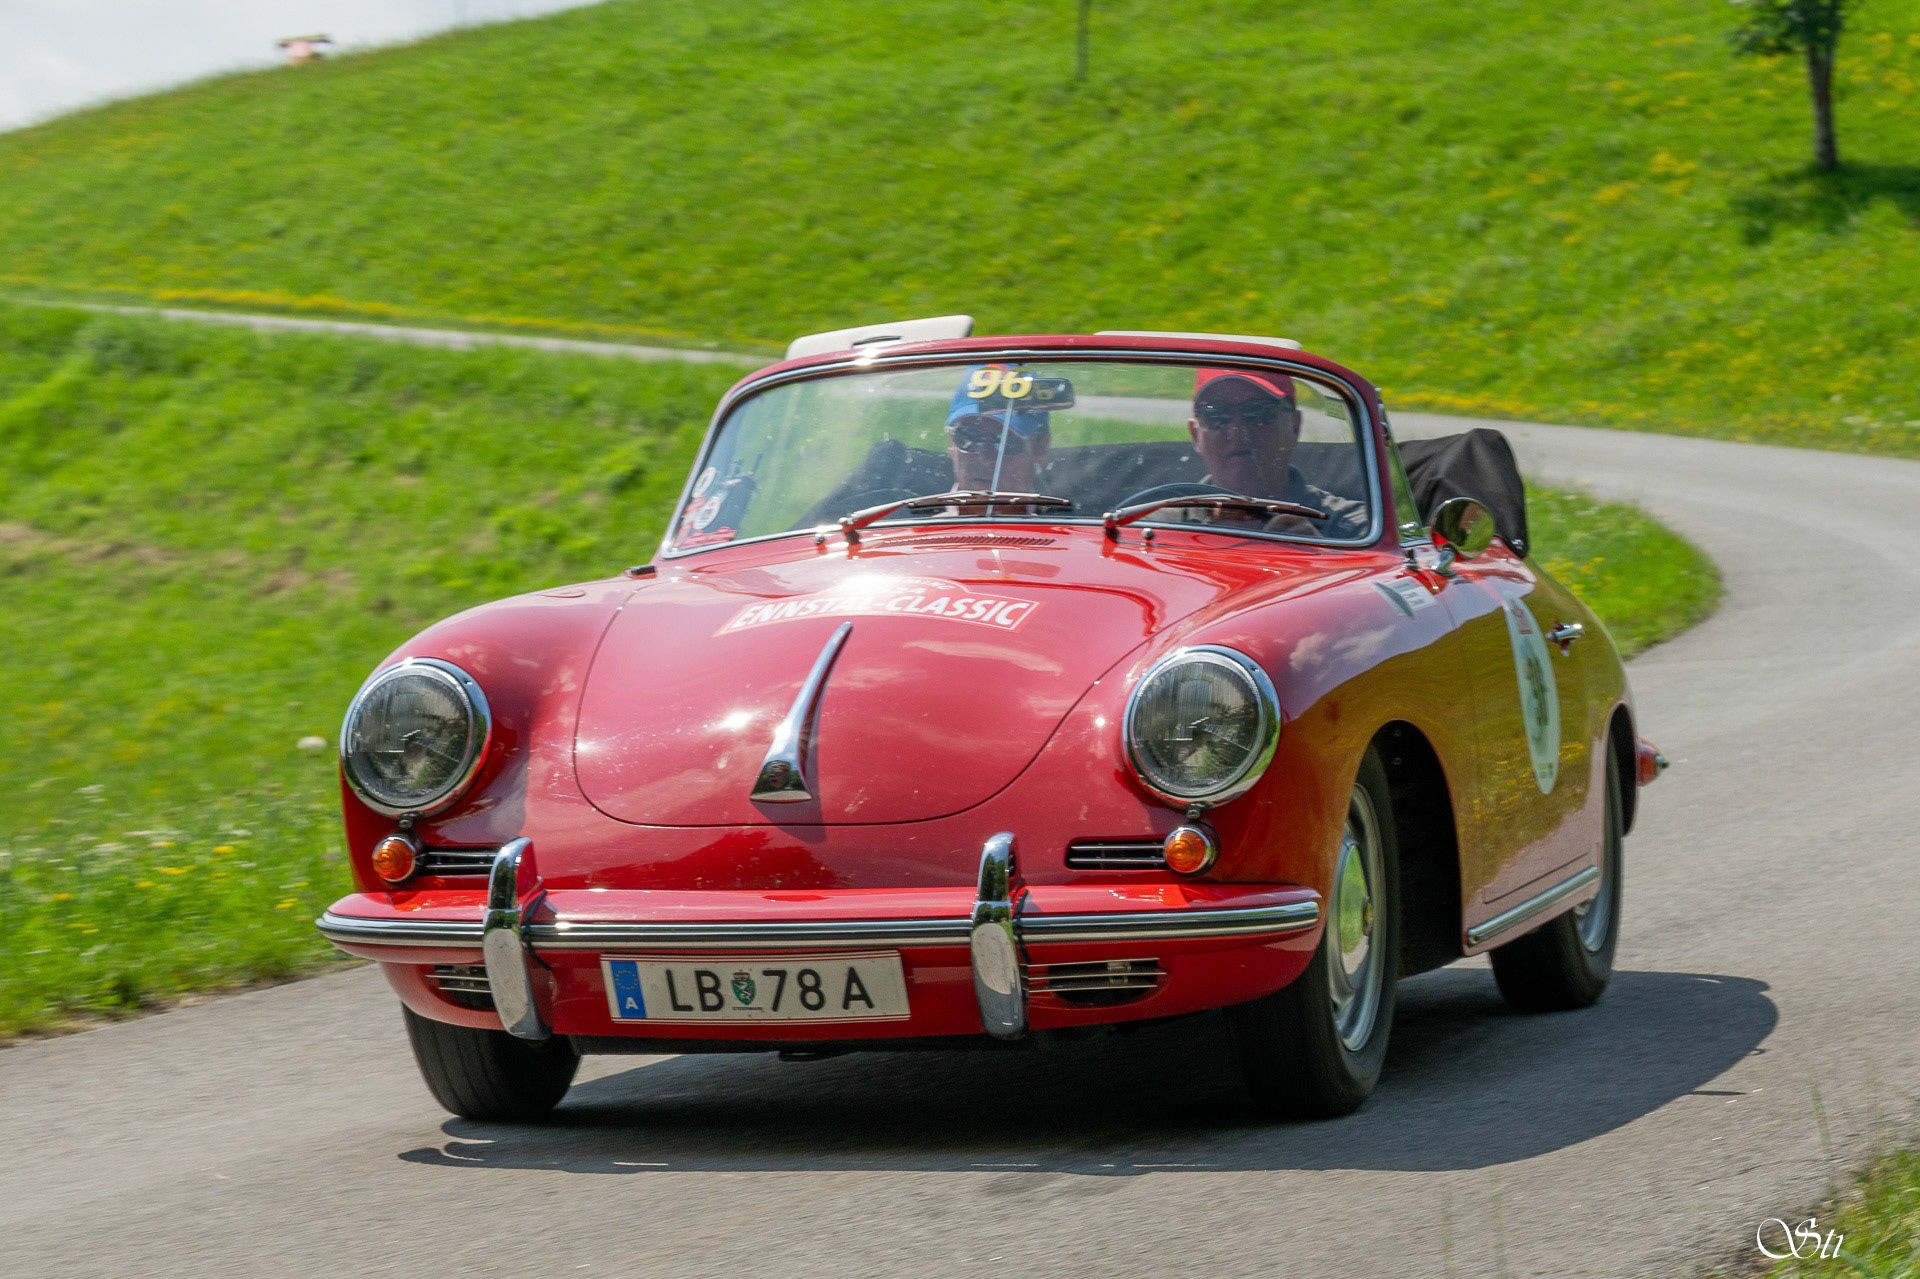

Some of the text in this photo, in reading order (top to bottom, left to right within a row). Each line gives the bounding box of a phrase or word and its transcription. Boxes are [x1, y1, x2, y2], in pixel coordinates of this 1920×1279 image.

[967, 369, 1032, 398] 96
[730, 596, 1029, 628] ENNSTAL-CLASSIC
[625, 997, 639, 1010] A
[665, 969, 724, 1012] LB
